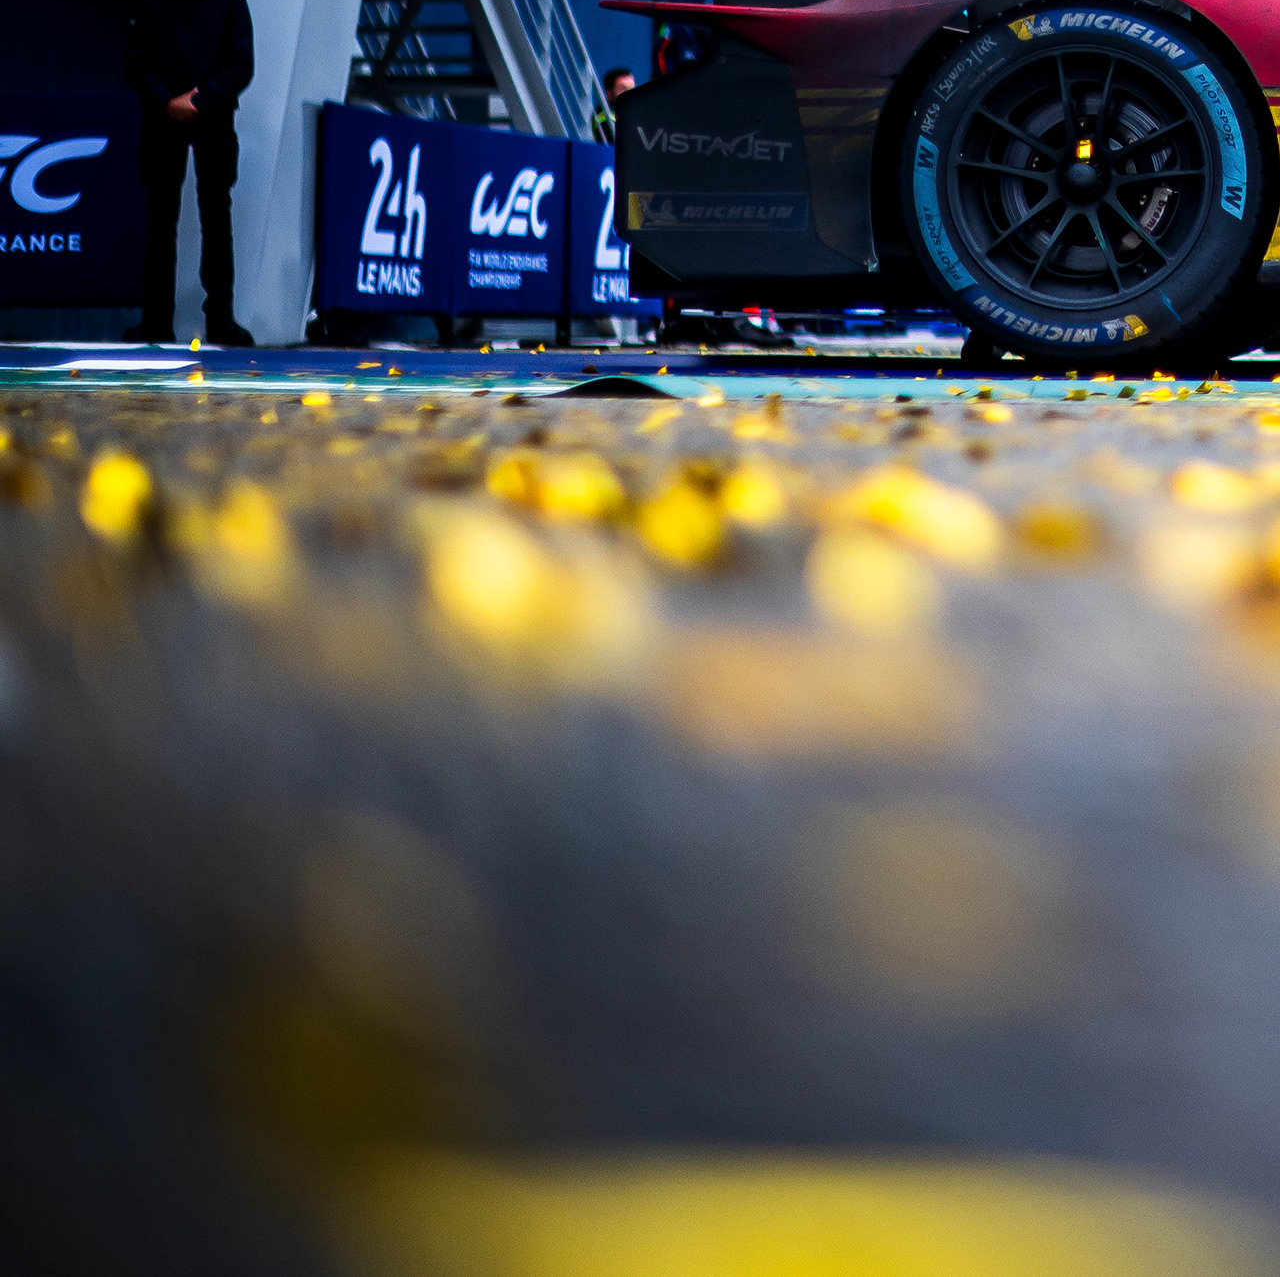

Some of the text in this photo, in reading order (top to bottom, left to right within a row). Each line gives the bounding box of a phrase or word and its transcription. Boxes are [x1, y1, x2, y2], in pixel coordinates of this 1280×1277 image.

[1059, 12, 1185, 60] MICHELIN
[1195, 73, 1223, 107] PILOT
[1216, 107, 1237, 150] SPORT
[360, 136, 427, 260] 24h
[469, 166, 555, 239] WEC
[682, 204, 794, 221] MICHELIN
[923, 206, 962, 282] PILOT SPORT
[356, 262, 423, 296] LE MANS
[593, 275, 608, 302] LE
[974, 294, 1098, 342] MICHELIN
